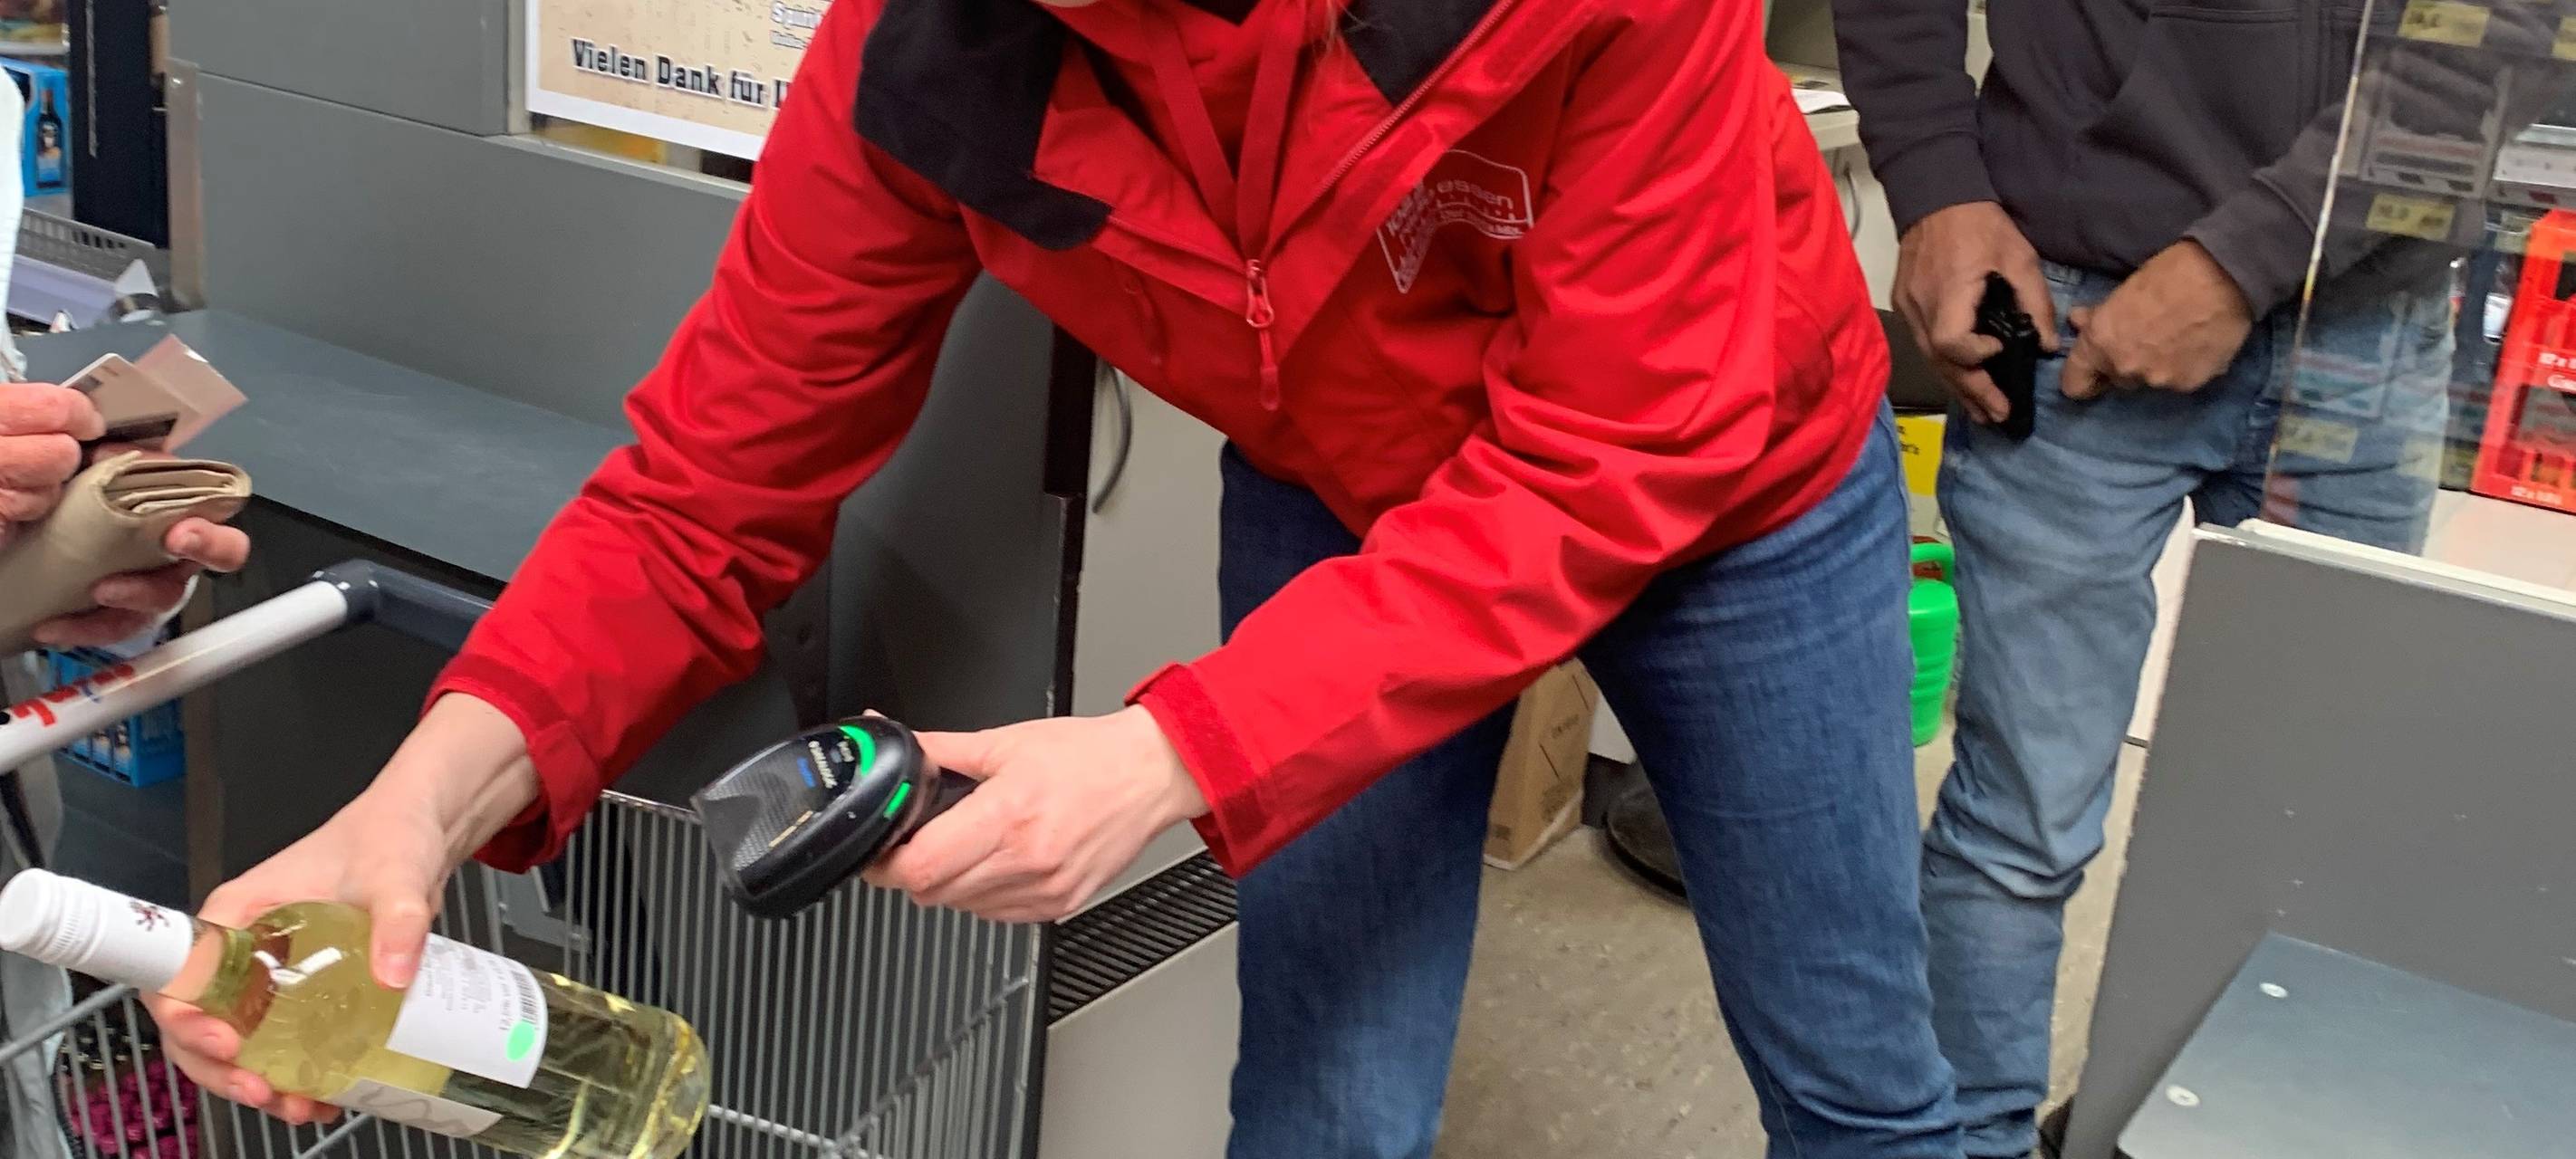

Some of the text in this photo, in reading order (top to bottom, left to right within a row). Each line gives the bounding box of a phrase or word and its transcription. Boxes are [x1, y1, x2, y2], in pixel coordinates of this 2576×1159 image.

[572, 38, 649, 81] Vielen
[656, 54, 722, 96] Dank
[729, 70, 765, 106] für
